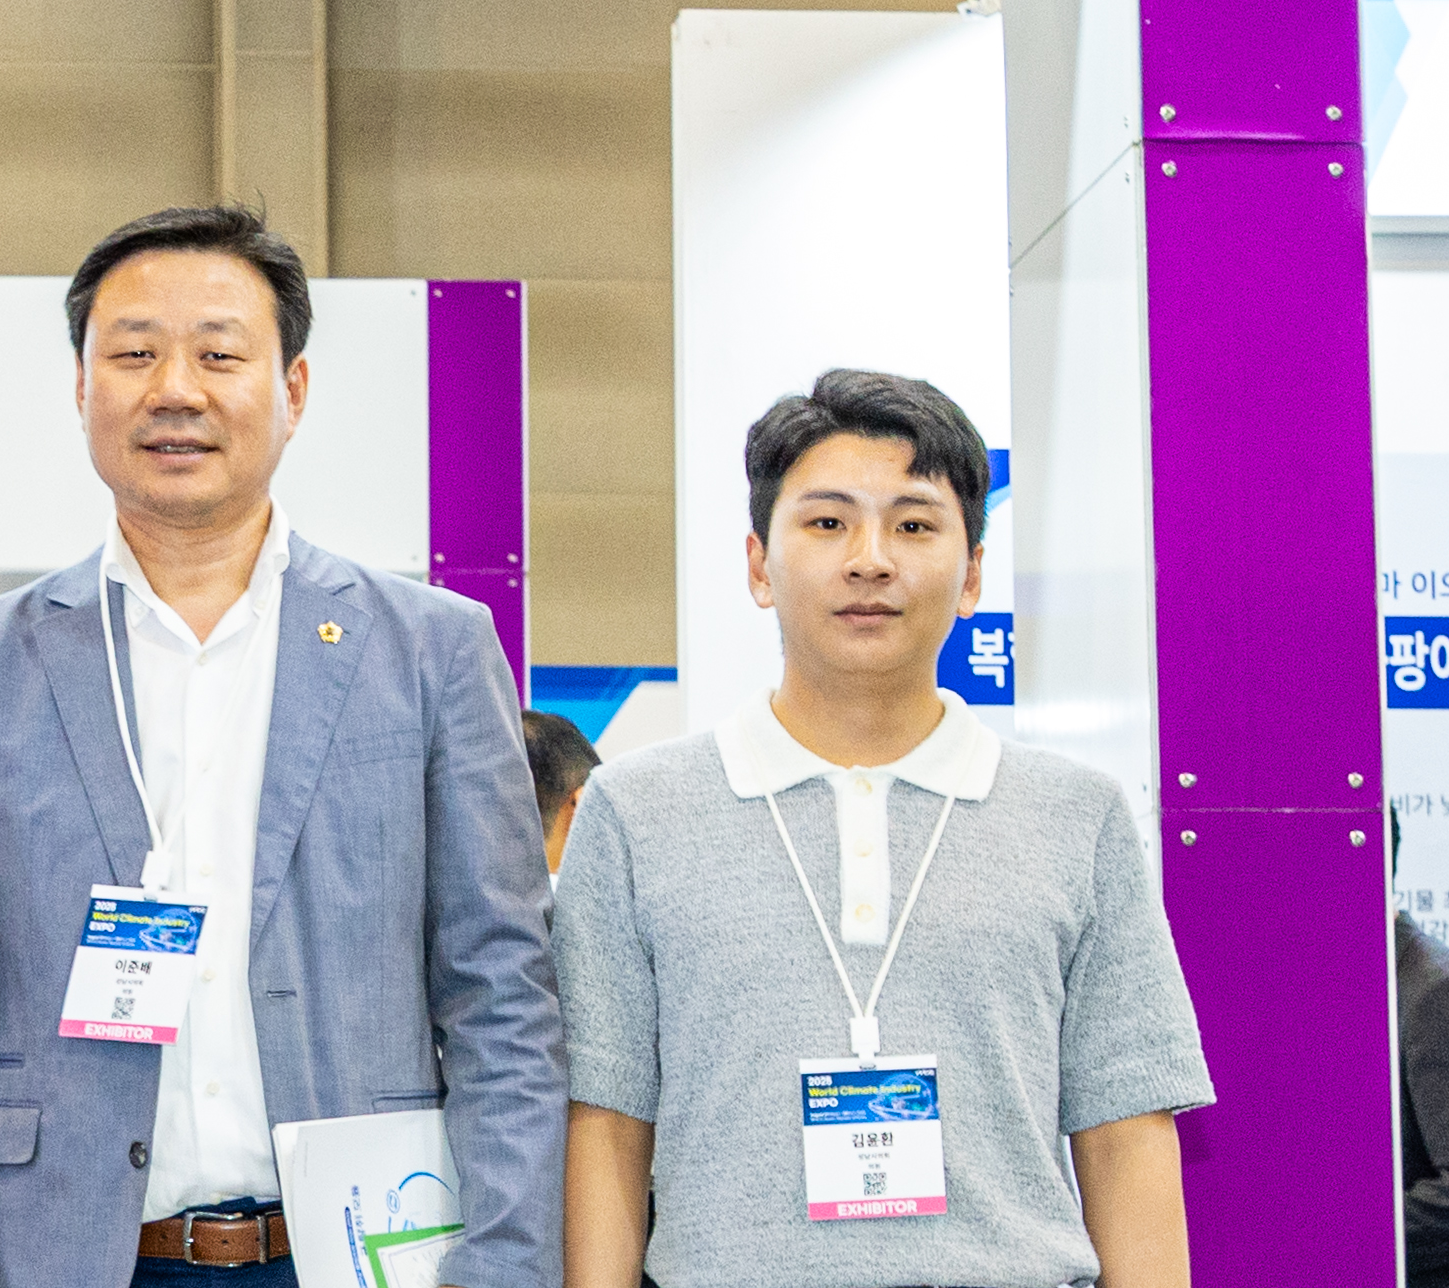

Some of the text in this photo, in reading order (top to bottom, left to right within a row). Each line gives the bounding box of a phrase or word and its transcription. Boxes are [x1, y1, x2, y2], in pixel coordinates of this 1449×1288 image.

[967, 625, 1015, 690] 복
[83, 1022, 155, 1041] EXHIBITOR
[808, 1083, 922, 1098] World Climate Industry
[807, 1096, 840, 1110] EXPO
[836, 1199, 919, 1218] EXHIBITOR
